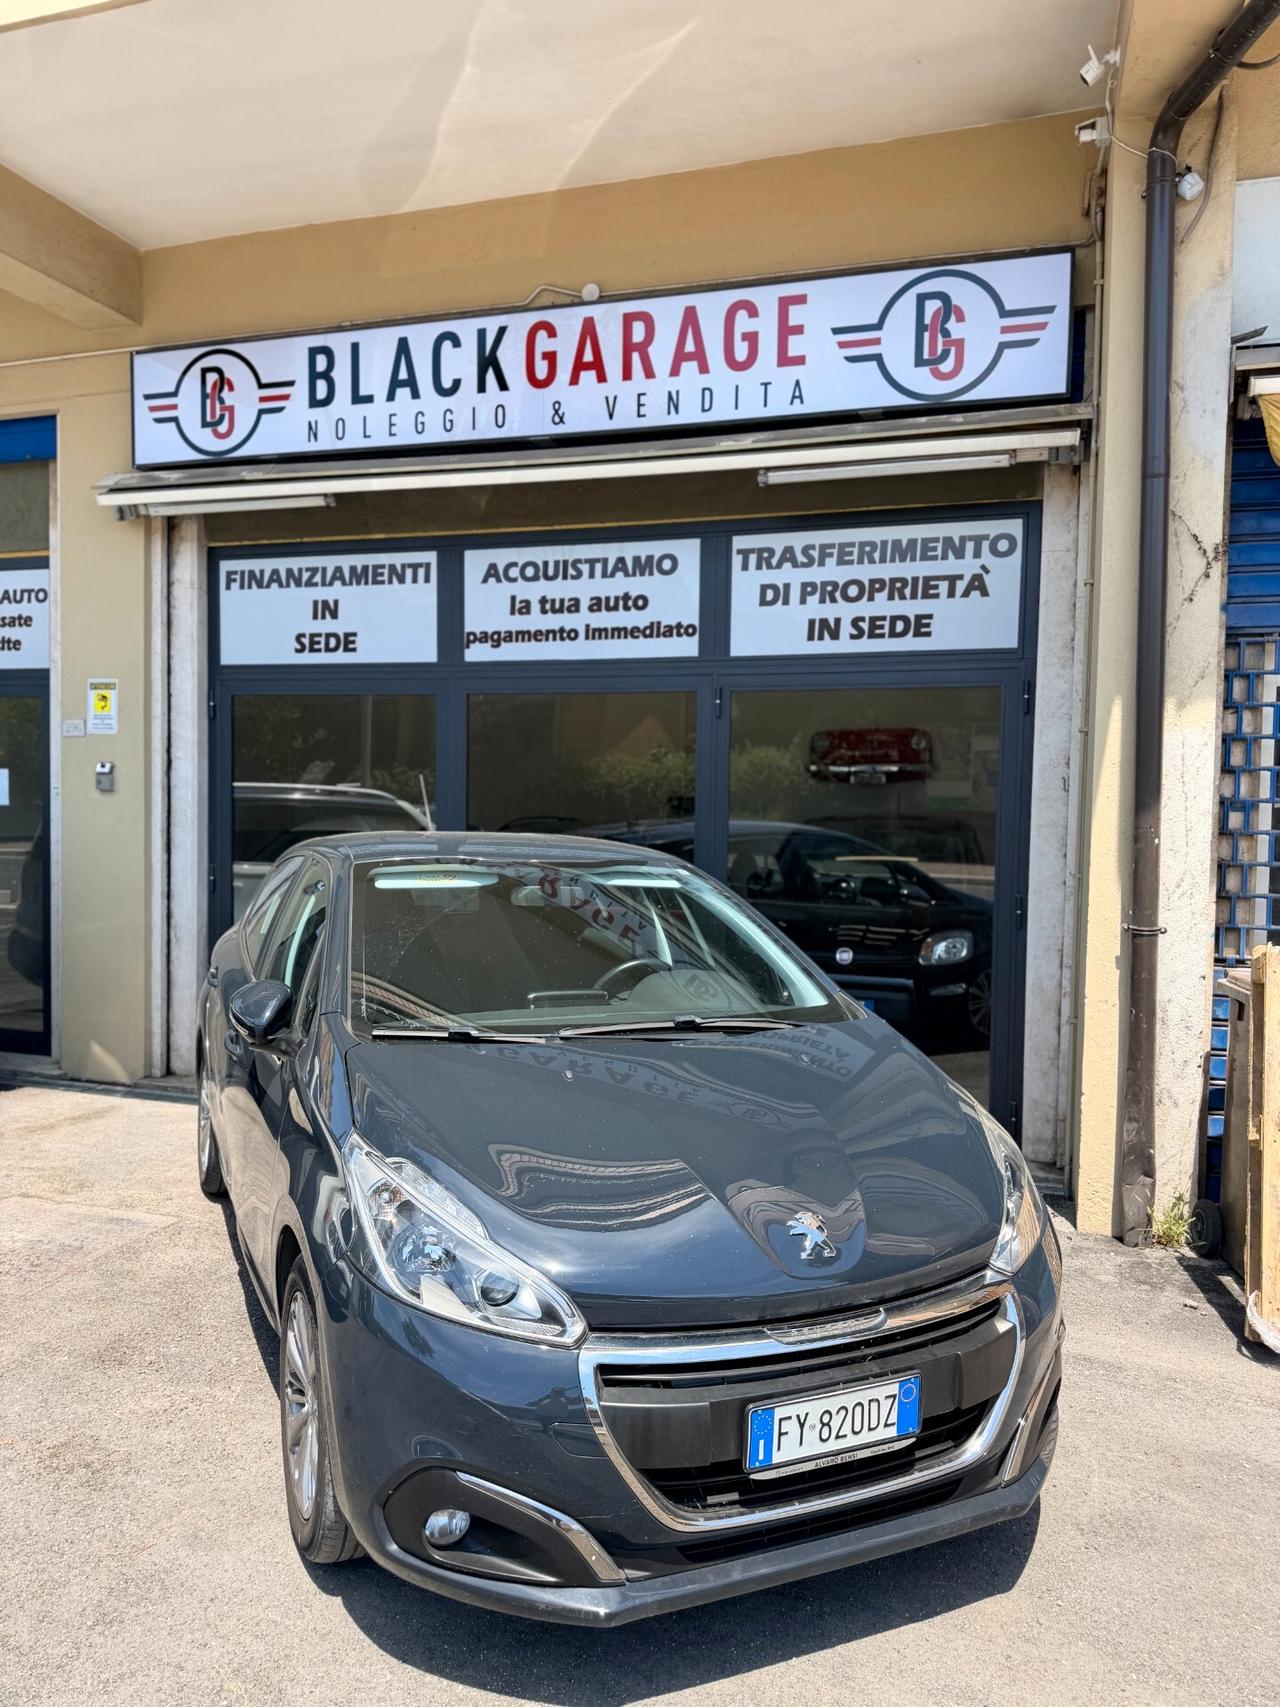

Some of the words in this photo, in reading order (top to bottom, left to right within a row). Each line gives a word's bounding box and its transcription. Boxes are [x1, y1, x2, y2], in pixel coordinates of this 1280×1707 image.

[307, 403, 508, 443] NOLEGGIO
[551, 400, 566, 426] &
[605, 379, 805, 422] VENDITA
[736, 532, 1018, 571] TRASFERIMENTO
[225, 562, 432, 591] FINANZIAMENTI
[481, 553, 679, 584] ACQUISTIAMO
[0, 588, 48, 604] AUTO
[759, 582, 791, 607] DI
[799, 563, 991, 606] PROPRIETÀ
[312, 599, 339, 620] IN
[510, 594, 532, 616] la
[539, 594, 581, 615] tua
[587, 591, 650, 613] auto
[464, 625, 580, 649] pagamento
[584, 620, 698, 641] immediato
[807, 617, 841, 641] IN
[849, 613, 934, 639] SEDE
[294, 631, 358, 654] SEDE
[814, 1457, 839, 1469] ALVARO
